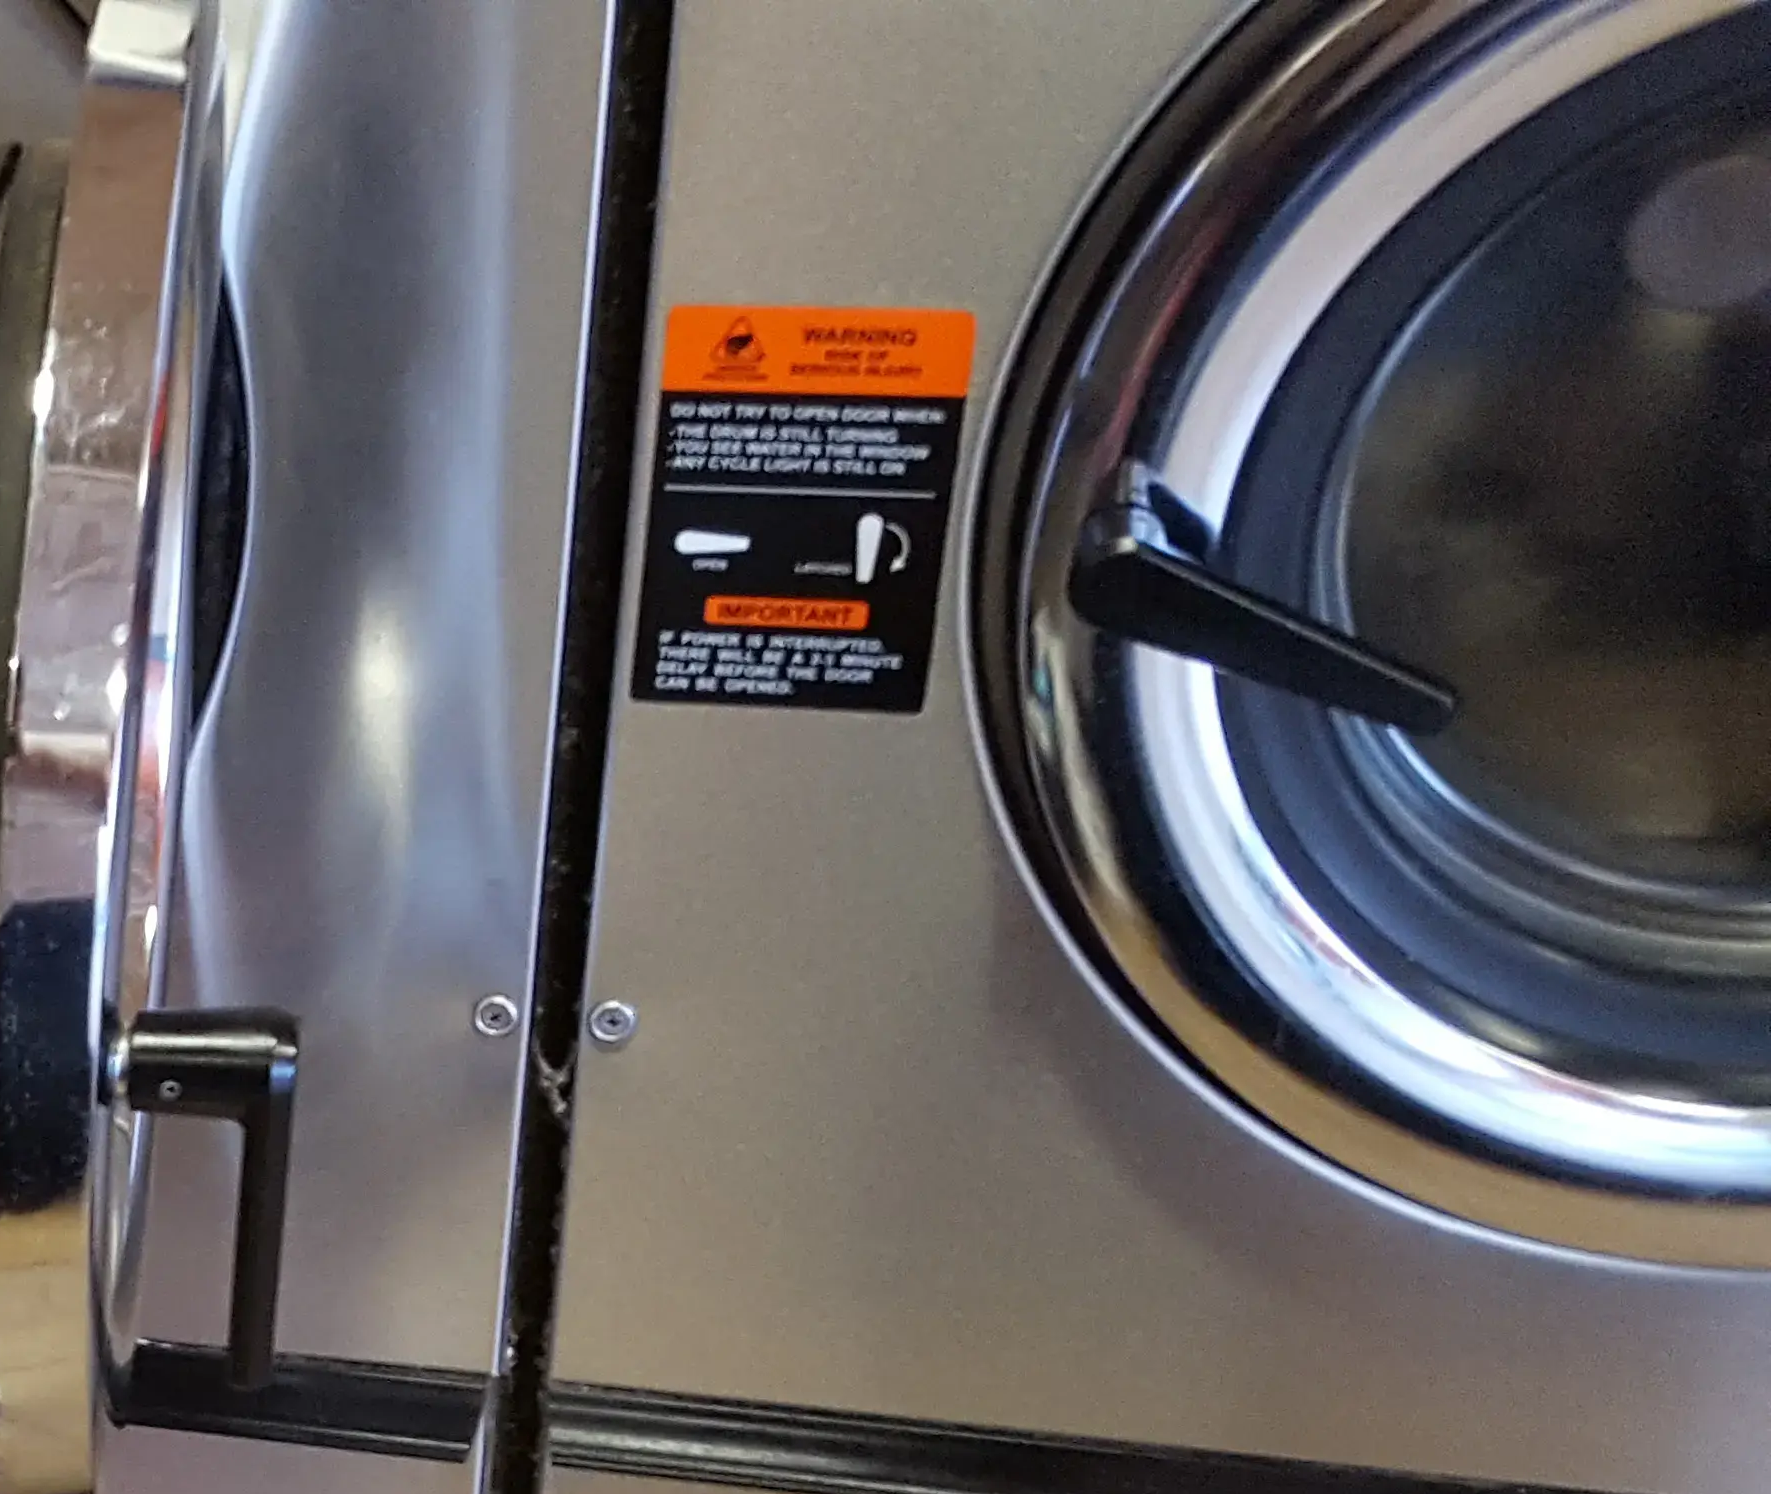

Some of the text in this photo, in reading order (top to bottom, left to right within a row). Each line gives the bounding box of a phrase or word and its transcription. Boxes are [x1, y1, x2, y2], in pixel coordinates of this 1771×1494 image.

[804, 328, 917, 346] WARNING
[669, 402, 697, 419] DO
[697, 403, 732, 420] NOT
[735, 404, 767, 420] TRY
[769, 404, 792, 421] TO
[793, 404, 840, 422] OPEN
[760, 425, 777, 442] IS
[777, 425, 824, 442] STILL
[708, 456, 762, 472] CYCLE
[763, 456, 812, 473] LIGHT
[812, 458, 831, 473] IS
[832, 458, 877, 475] STILL
[878, 460, 906, 476] ON
[717, 603, 855, 625] IMPORTANT
[680, 631, 742, 646] POWER
[659, 646, 710, 661] THERE
[790, 651, 806, 665] A
[656, 660, 708, 675] DELAY
[786, 665, 819, 681] THE
[654, 675, 690, 690] CAN
